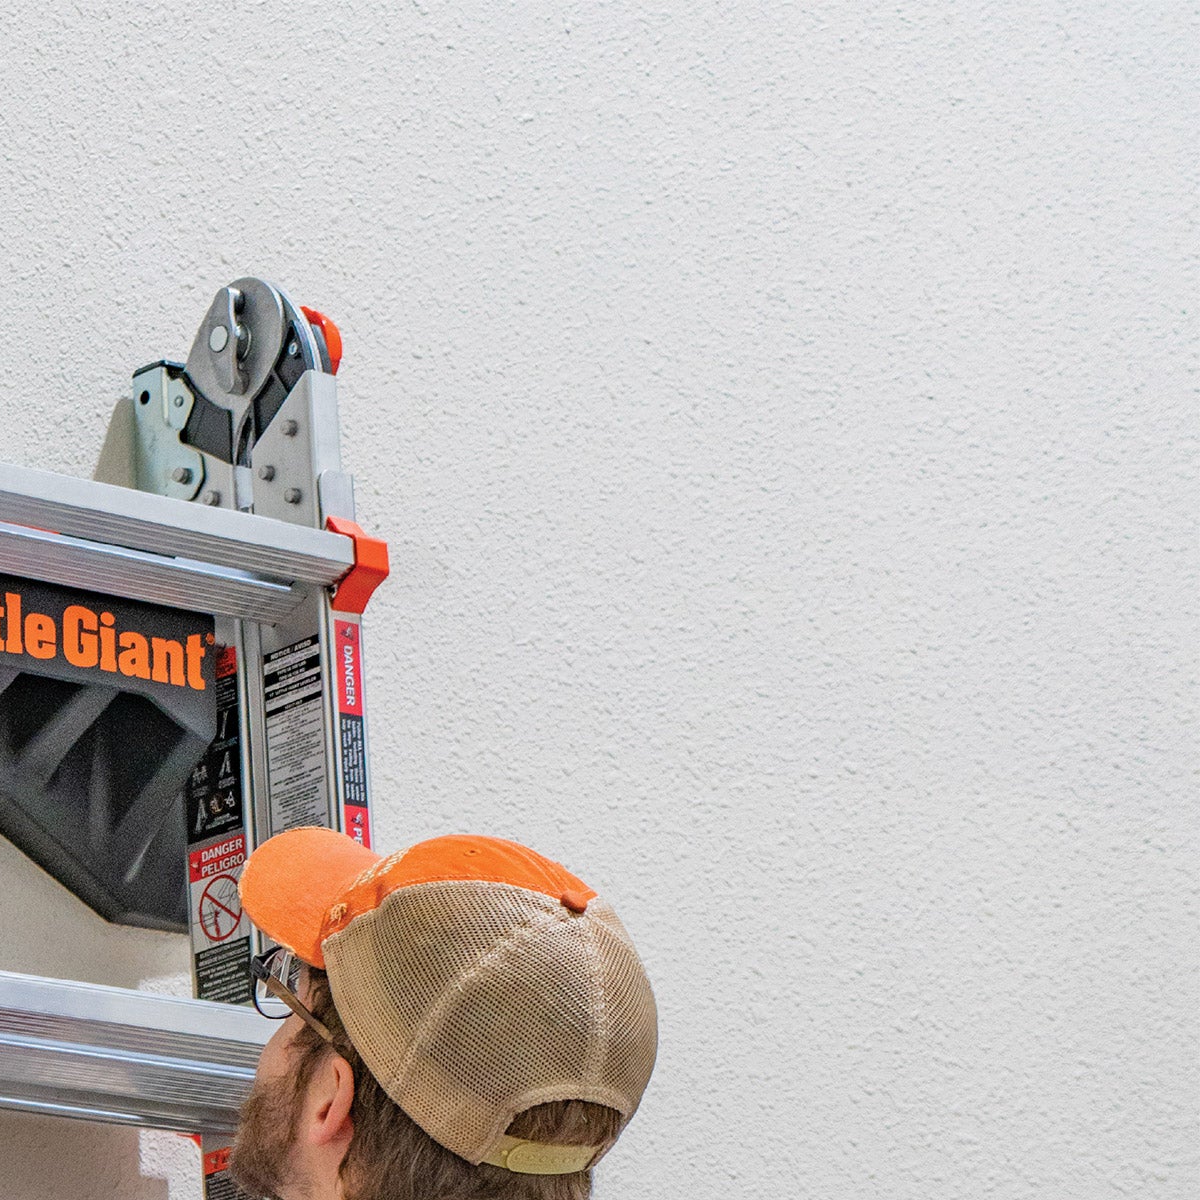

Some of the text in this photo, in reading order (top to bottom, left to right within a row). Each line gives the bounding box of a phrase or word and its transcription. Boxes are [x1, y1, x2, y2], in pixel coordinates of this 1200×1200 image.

[63, 605, 206, 691] Giant
[343, 644, 356, 706] DANGER
[201, 838, 243, 863] DANGER
[201, 852, 245, 878] PELIGRO
